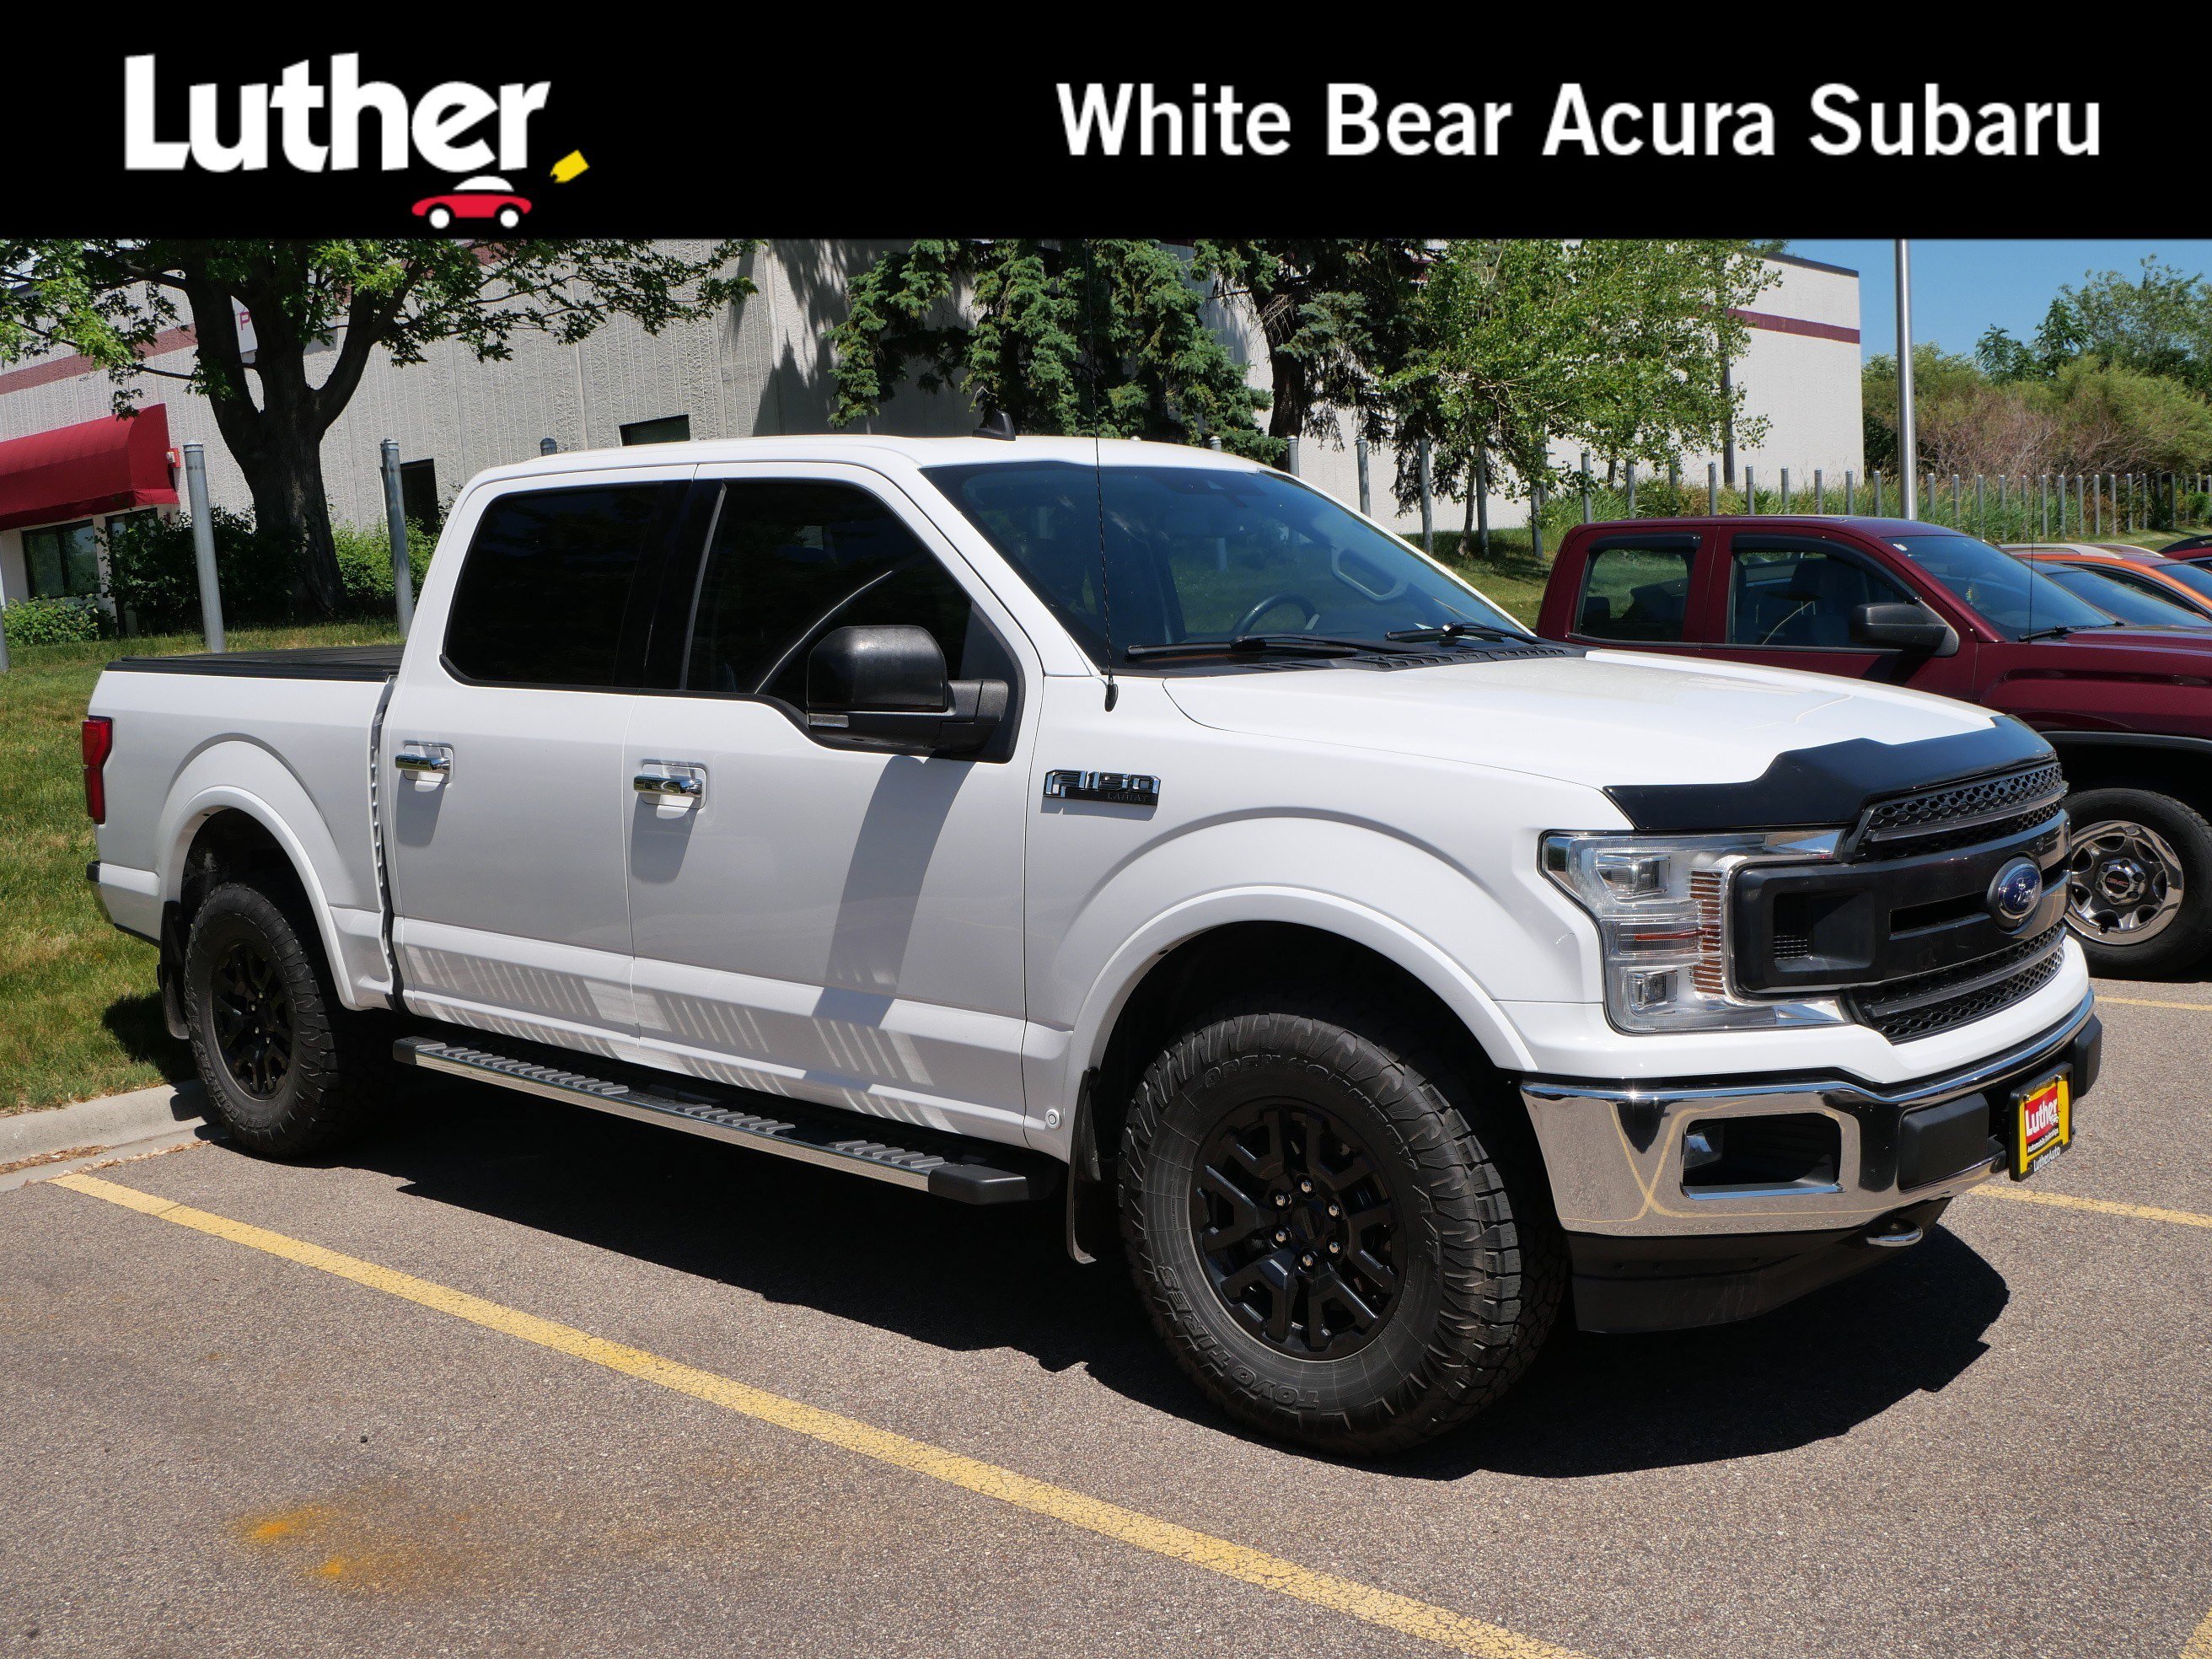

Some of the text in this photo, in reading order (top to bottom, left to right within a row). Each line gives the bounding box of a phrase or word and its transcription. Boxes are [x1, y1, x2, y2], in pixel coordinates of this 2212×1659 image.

[2106, 877, 2129, 889] GMC
[2025, 1098, 2059, 1136] Luther
[1156, 1265, 1232, 1372] TIRES
[1232, 1366, 1320, 1411] TOYO
